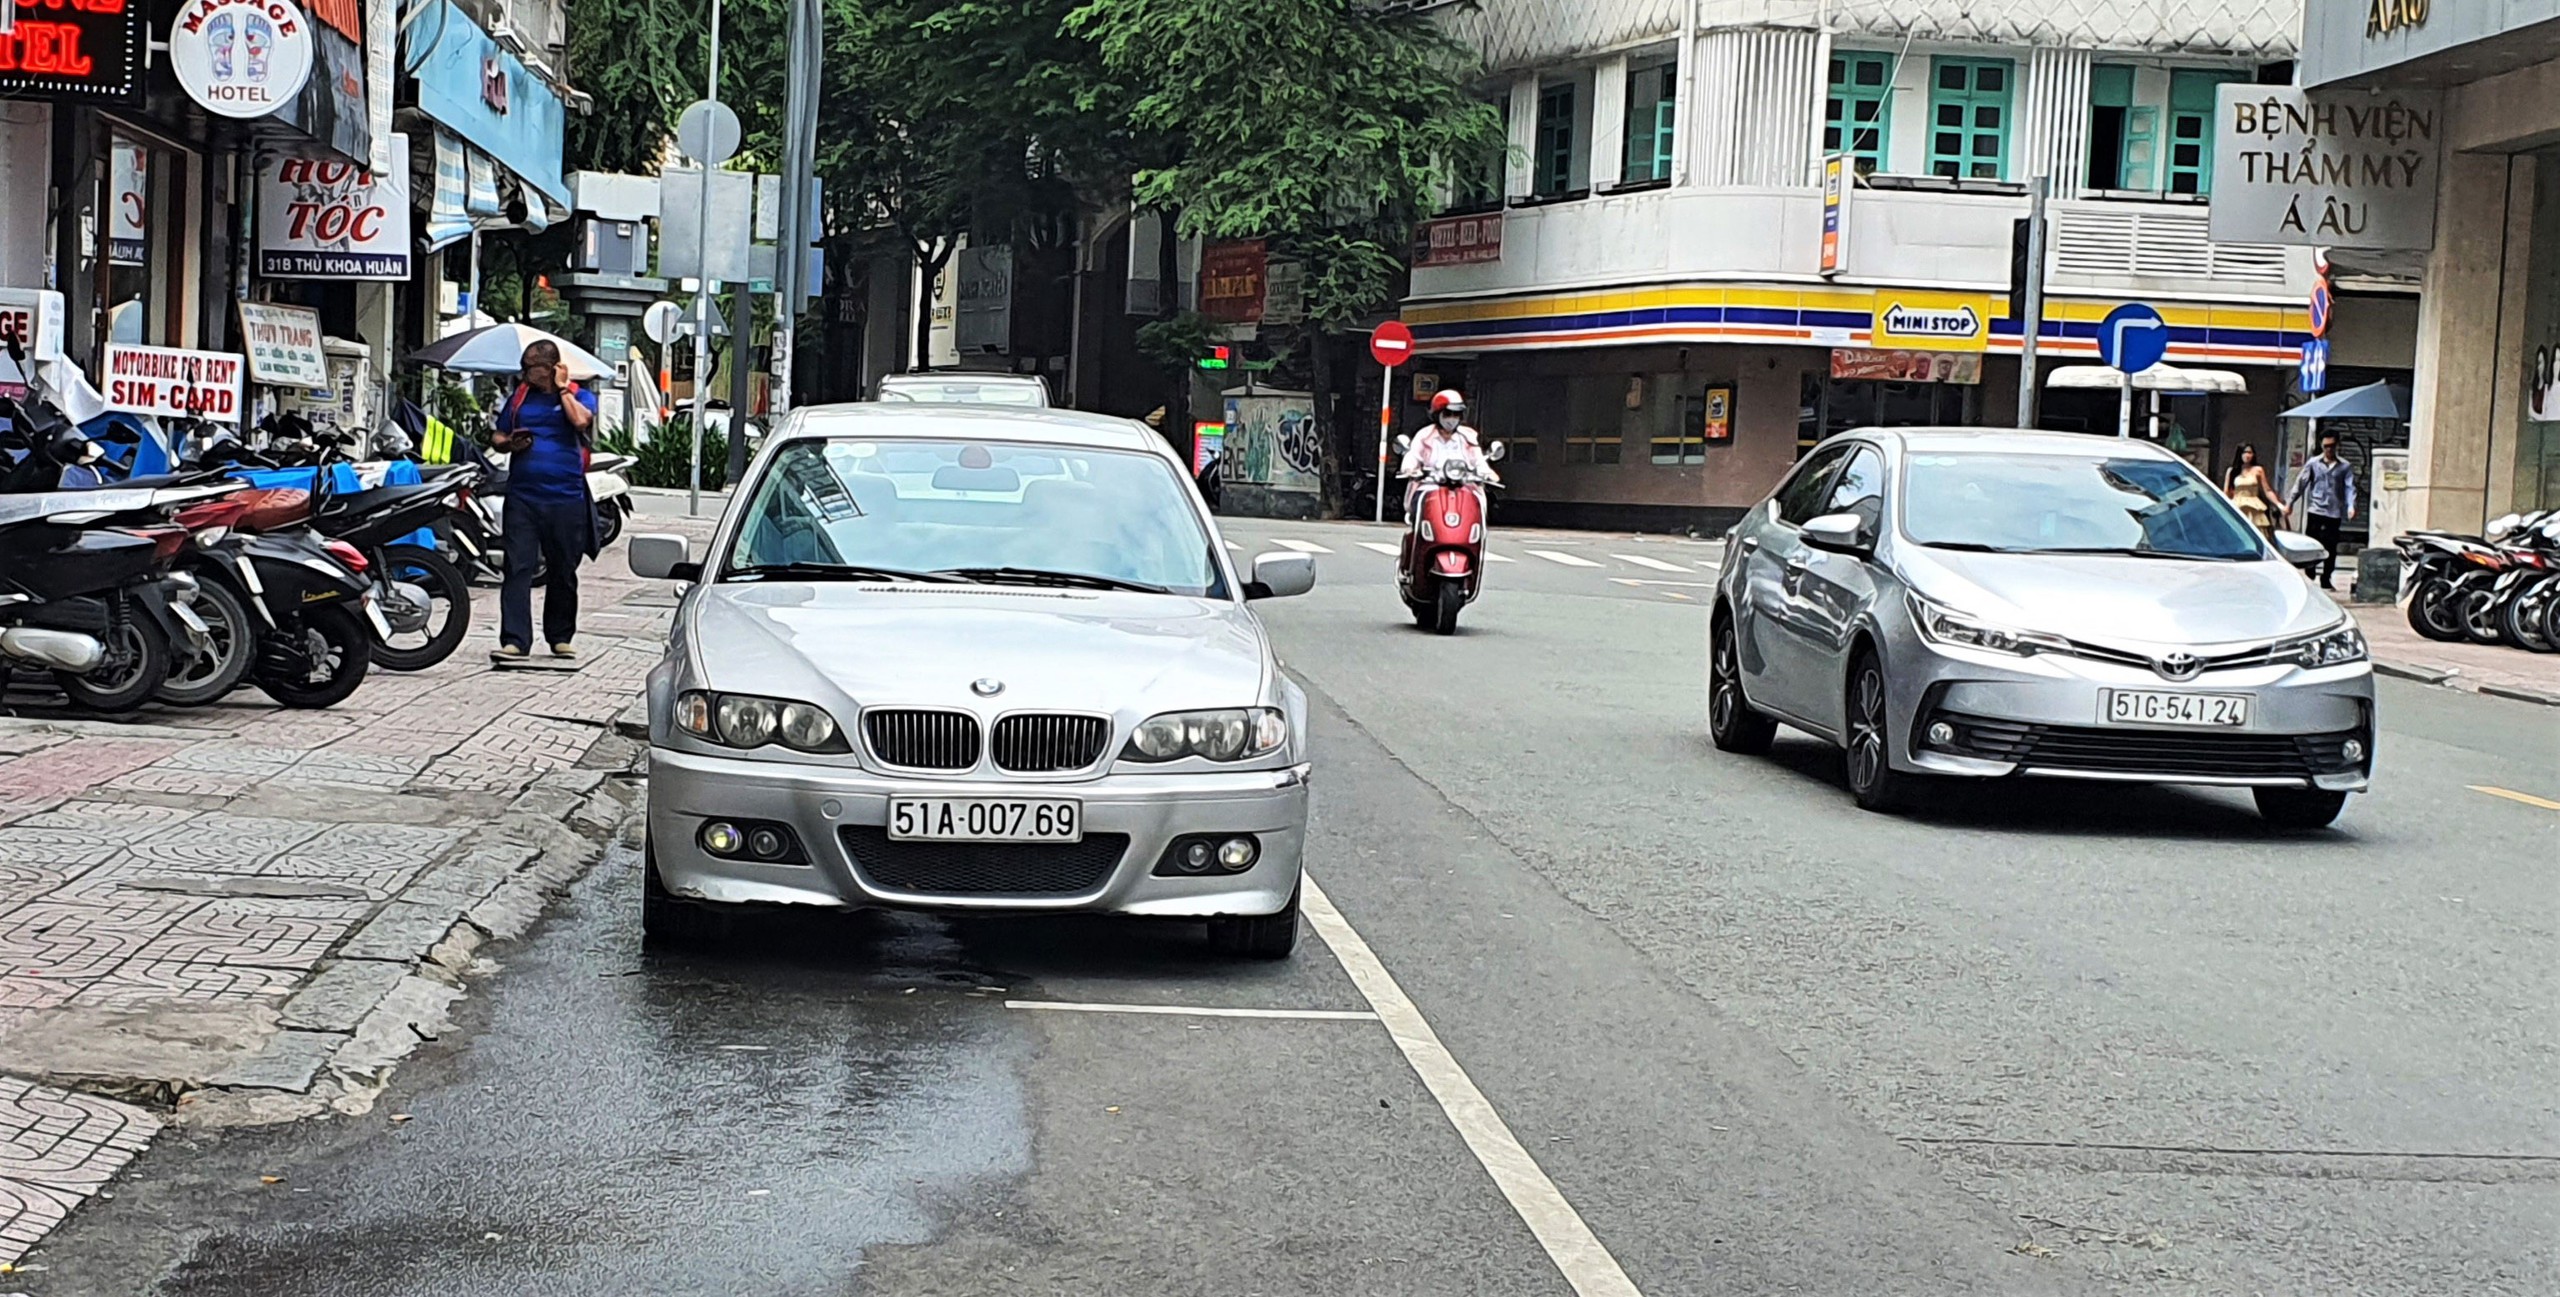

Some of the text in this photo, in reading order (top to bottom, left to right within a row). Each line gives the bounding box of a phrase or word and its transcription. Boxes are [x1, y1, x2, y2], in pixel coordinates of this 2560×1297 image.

[208, 85, 271, 102] HOTEL
[2234, 96, 2432, 147] BỆNH VIỆN
[2239, 137, 2424, 187] THẨM MỸ
[2279, 193, 2368, 235] Á ÂU
[267, 253, 402, 275] 31B THỦ KHOA HUÂN
[1893, 315, 1970, 331] MINI STOP
[112, 349, 179, 380] MOTORBIKE
[206, 358, 236, 385] RENT
[2115, 693, 2240, 725] 51G-541.24
[895, 802, 1075, 836] 51A-007.69
